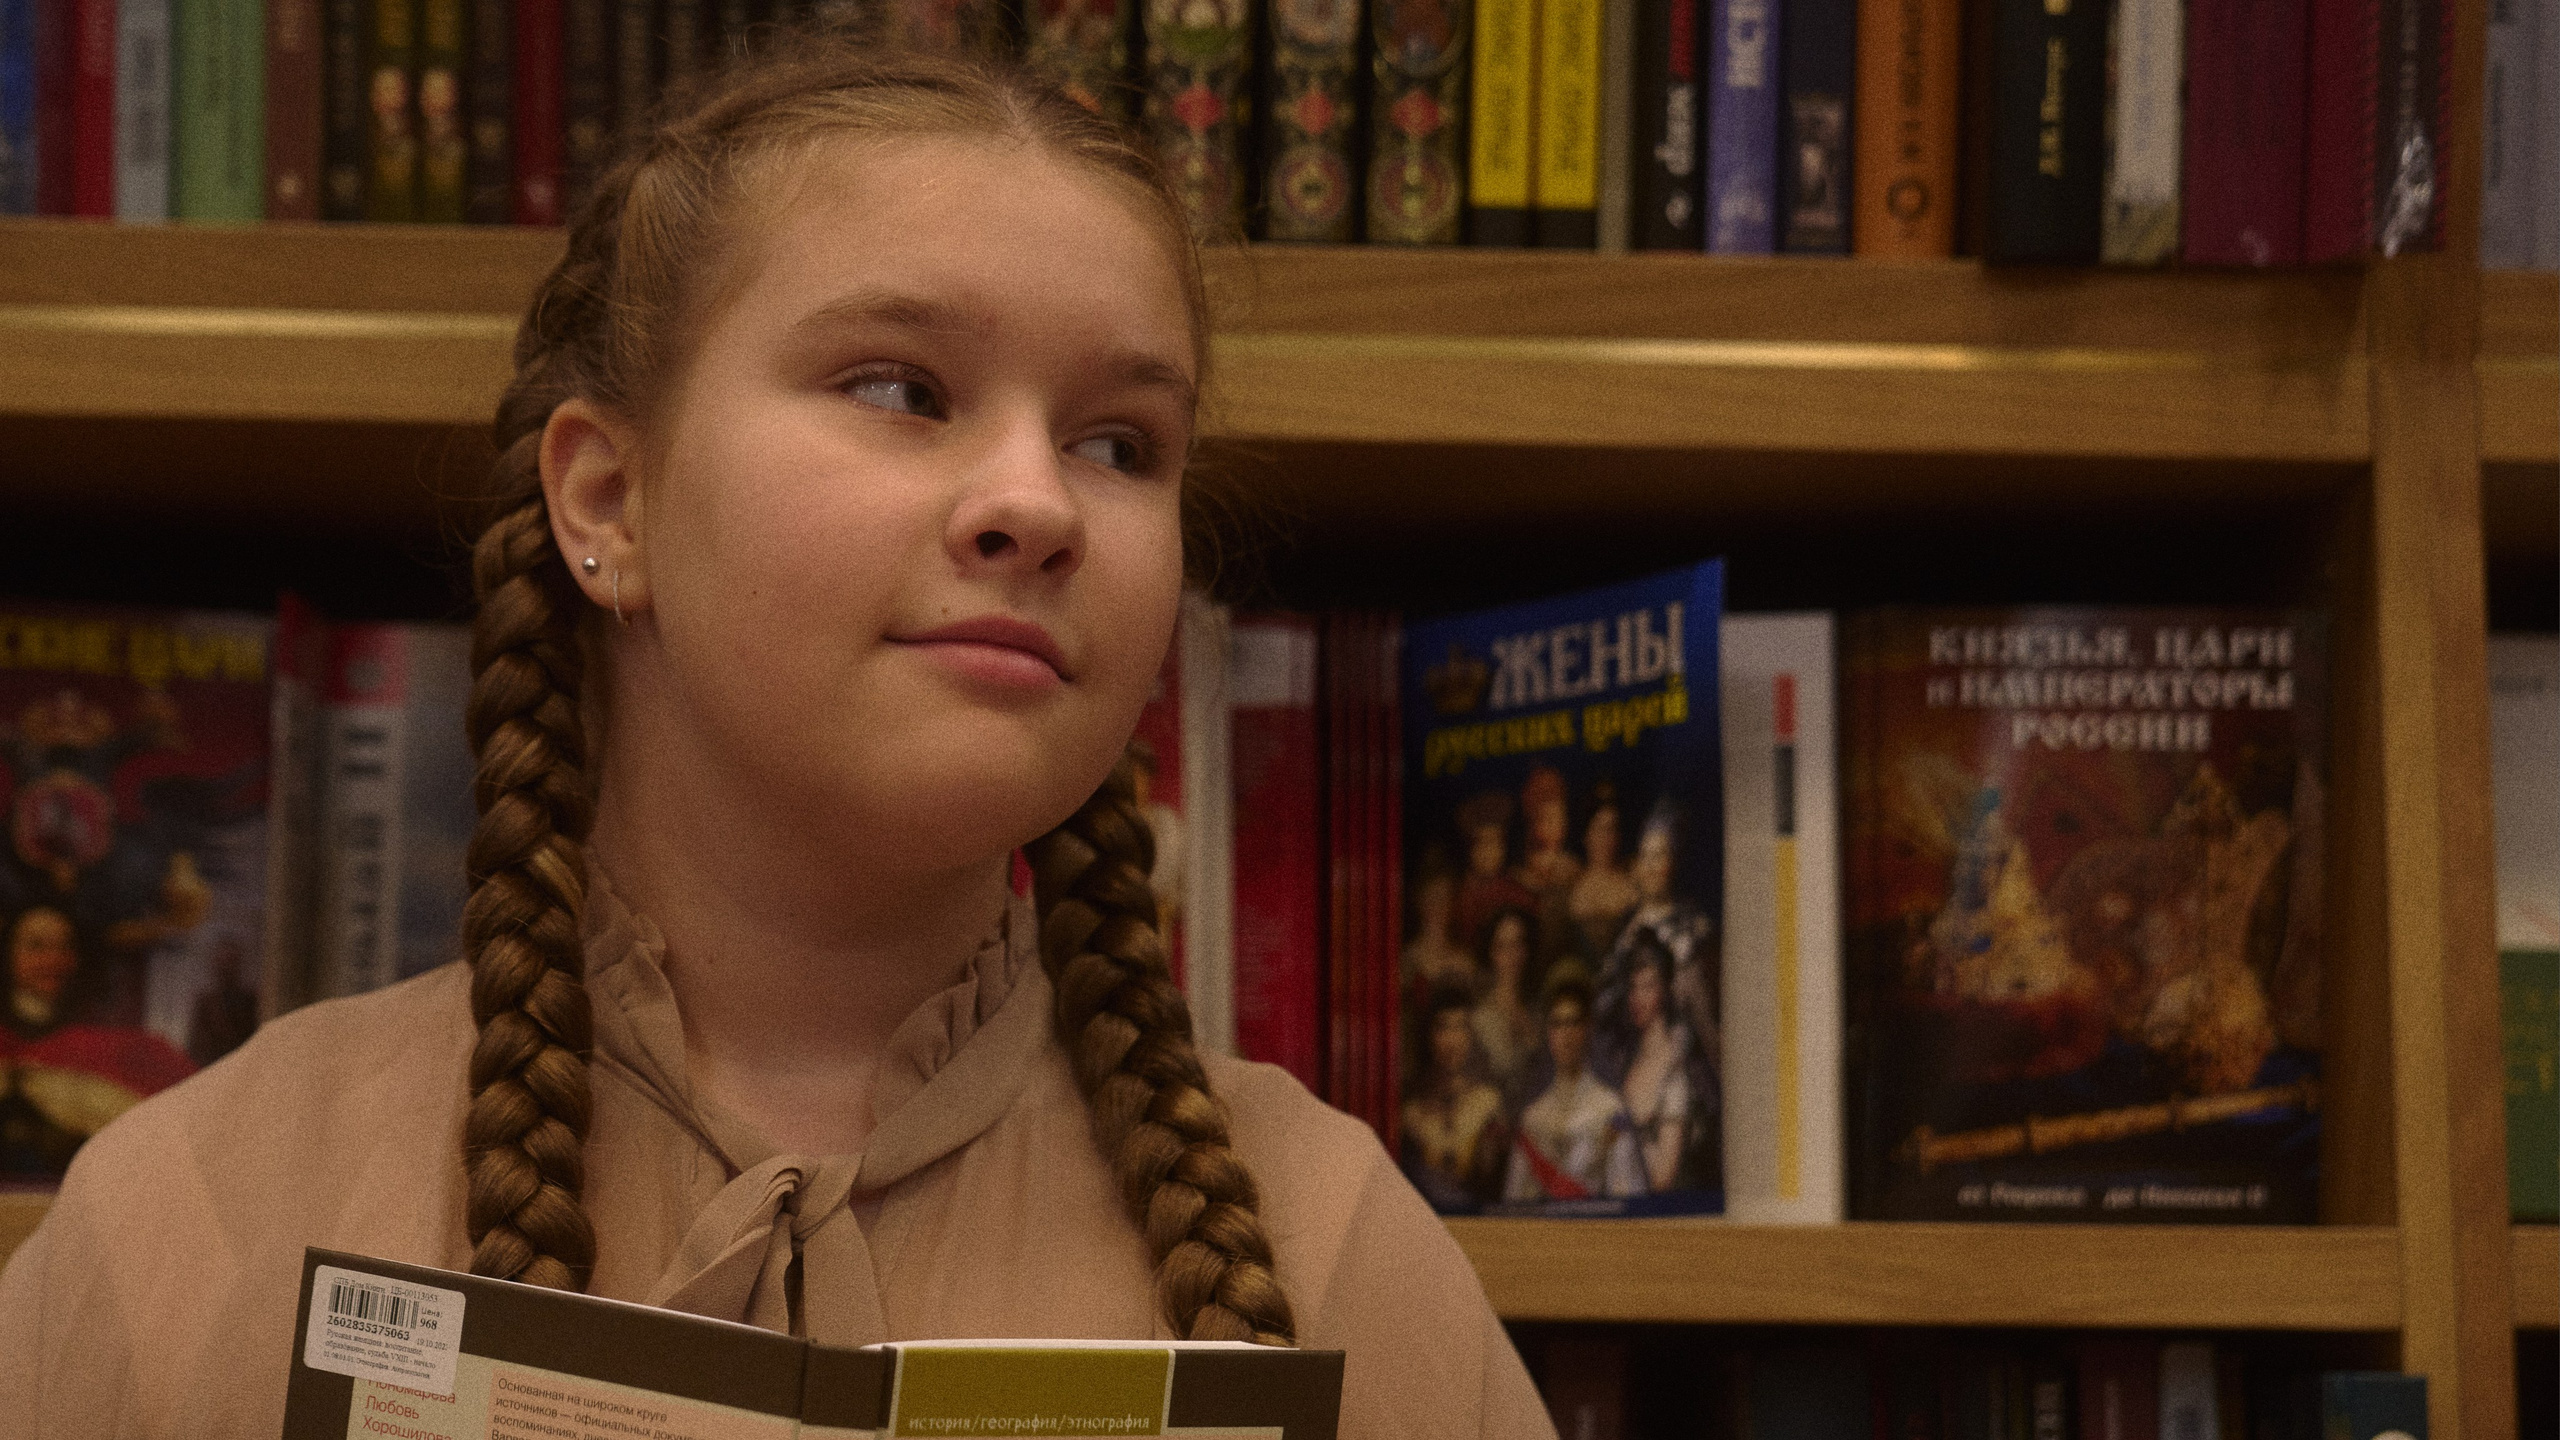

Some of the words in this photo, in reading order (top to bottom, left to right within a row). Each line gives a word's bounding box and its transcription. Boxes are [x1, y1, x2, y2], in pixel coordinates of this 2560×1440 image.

[1487, 599, 1685, 712] ЖЕНЫ
[2155, 626, 2294, 669] ЦАРИ
[1960, 669, 2295, 711] ИМПЕРАТОРЫ
[1424, 709, 1577, 781] русских
[1582, 674, 1689, 754] царей
[2011, 711, 2212, 753] РОССИИ
[326, 1314, 410, 1341] 2602835375063
[420, 1318, 438, 1330] 968
[365, 1395, 420, 1420] Любовь
[495, 1397, 558, 1419] источников
[574, 1412, 650, 1437] официальных
[498, 1378, 564, 1401] Основанная
[567, 1394, 581, 1405] на
[583, 1398, 634, 1415] широком
[637, 1408, 667, 1423] круге
[909, 1413, 1150, 1433] история/география/этнография
